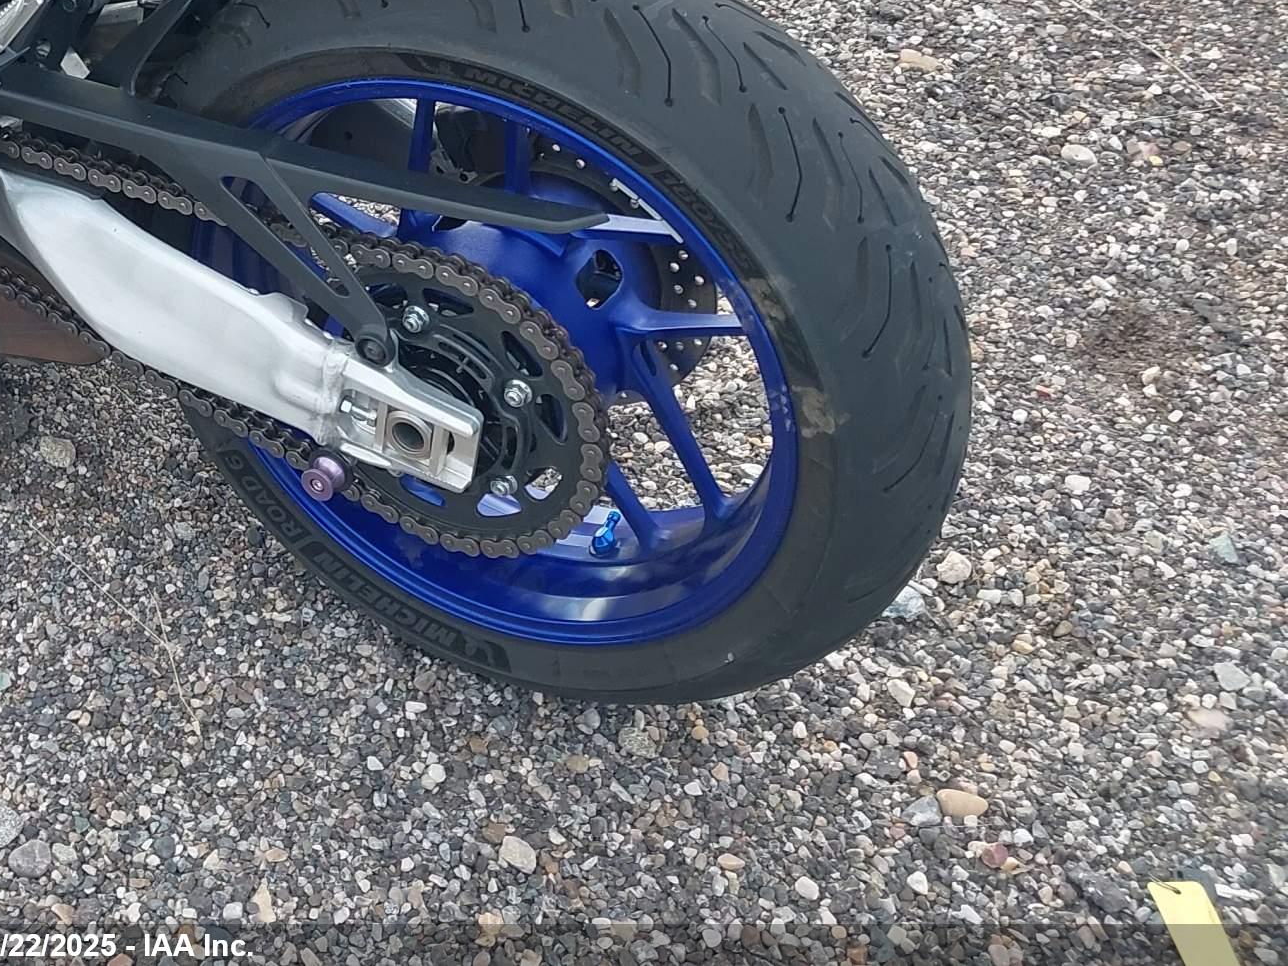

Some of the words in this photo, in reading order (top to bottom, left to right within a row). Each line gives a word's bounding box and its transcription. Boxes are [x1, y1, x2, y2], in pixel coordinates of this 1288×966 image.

[464, 67, 644, 156] MICHELIN
[225, 455, 244, 471] 6
[241, 475, 304, 537] ROAD
[313, 552, 458, 648] MICHELIN
